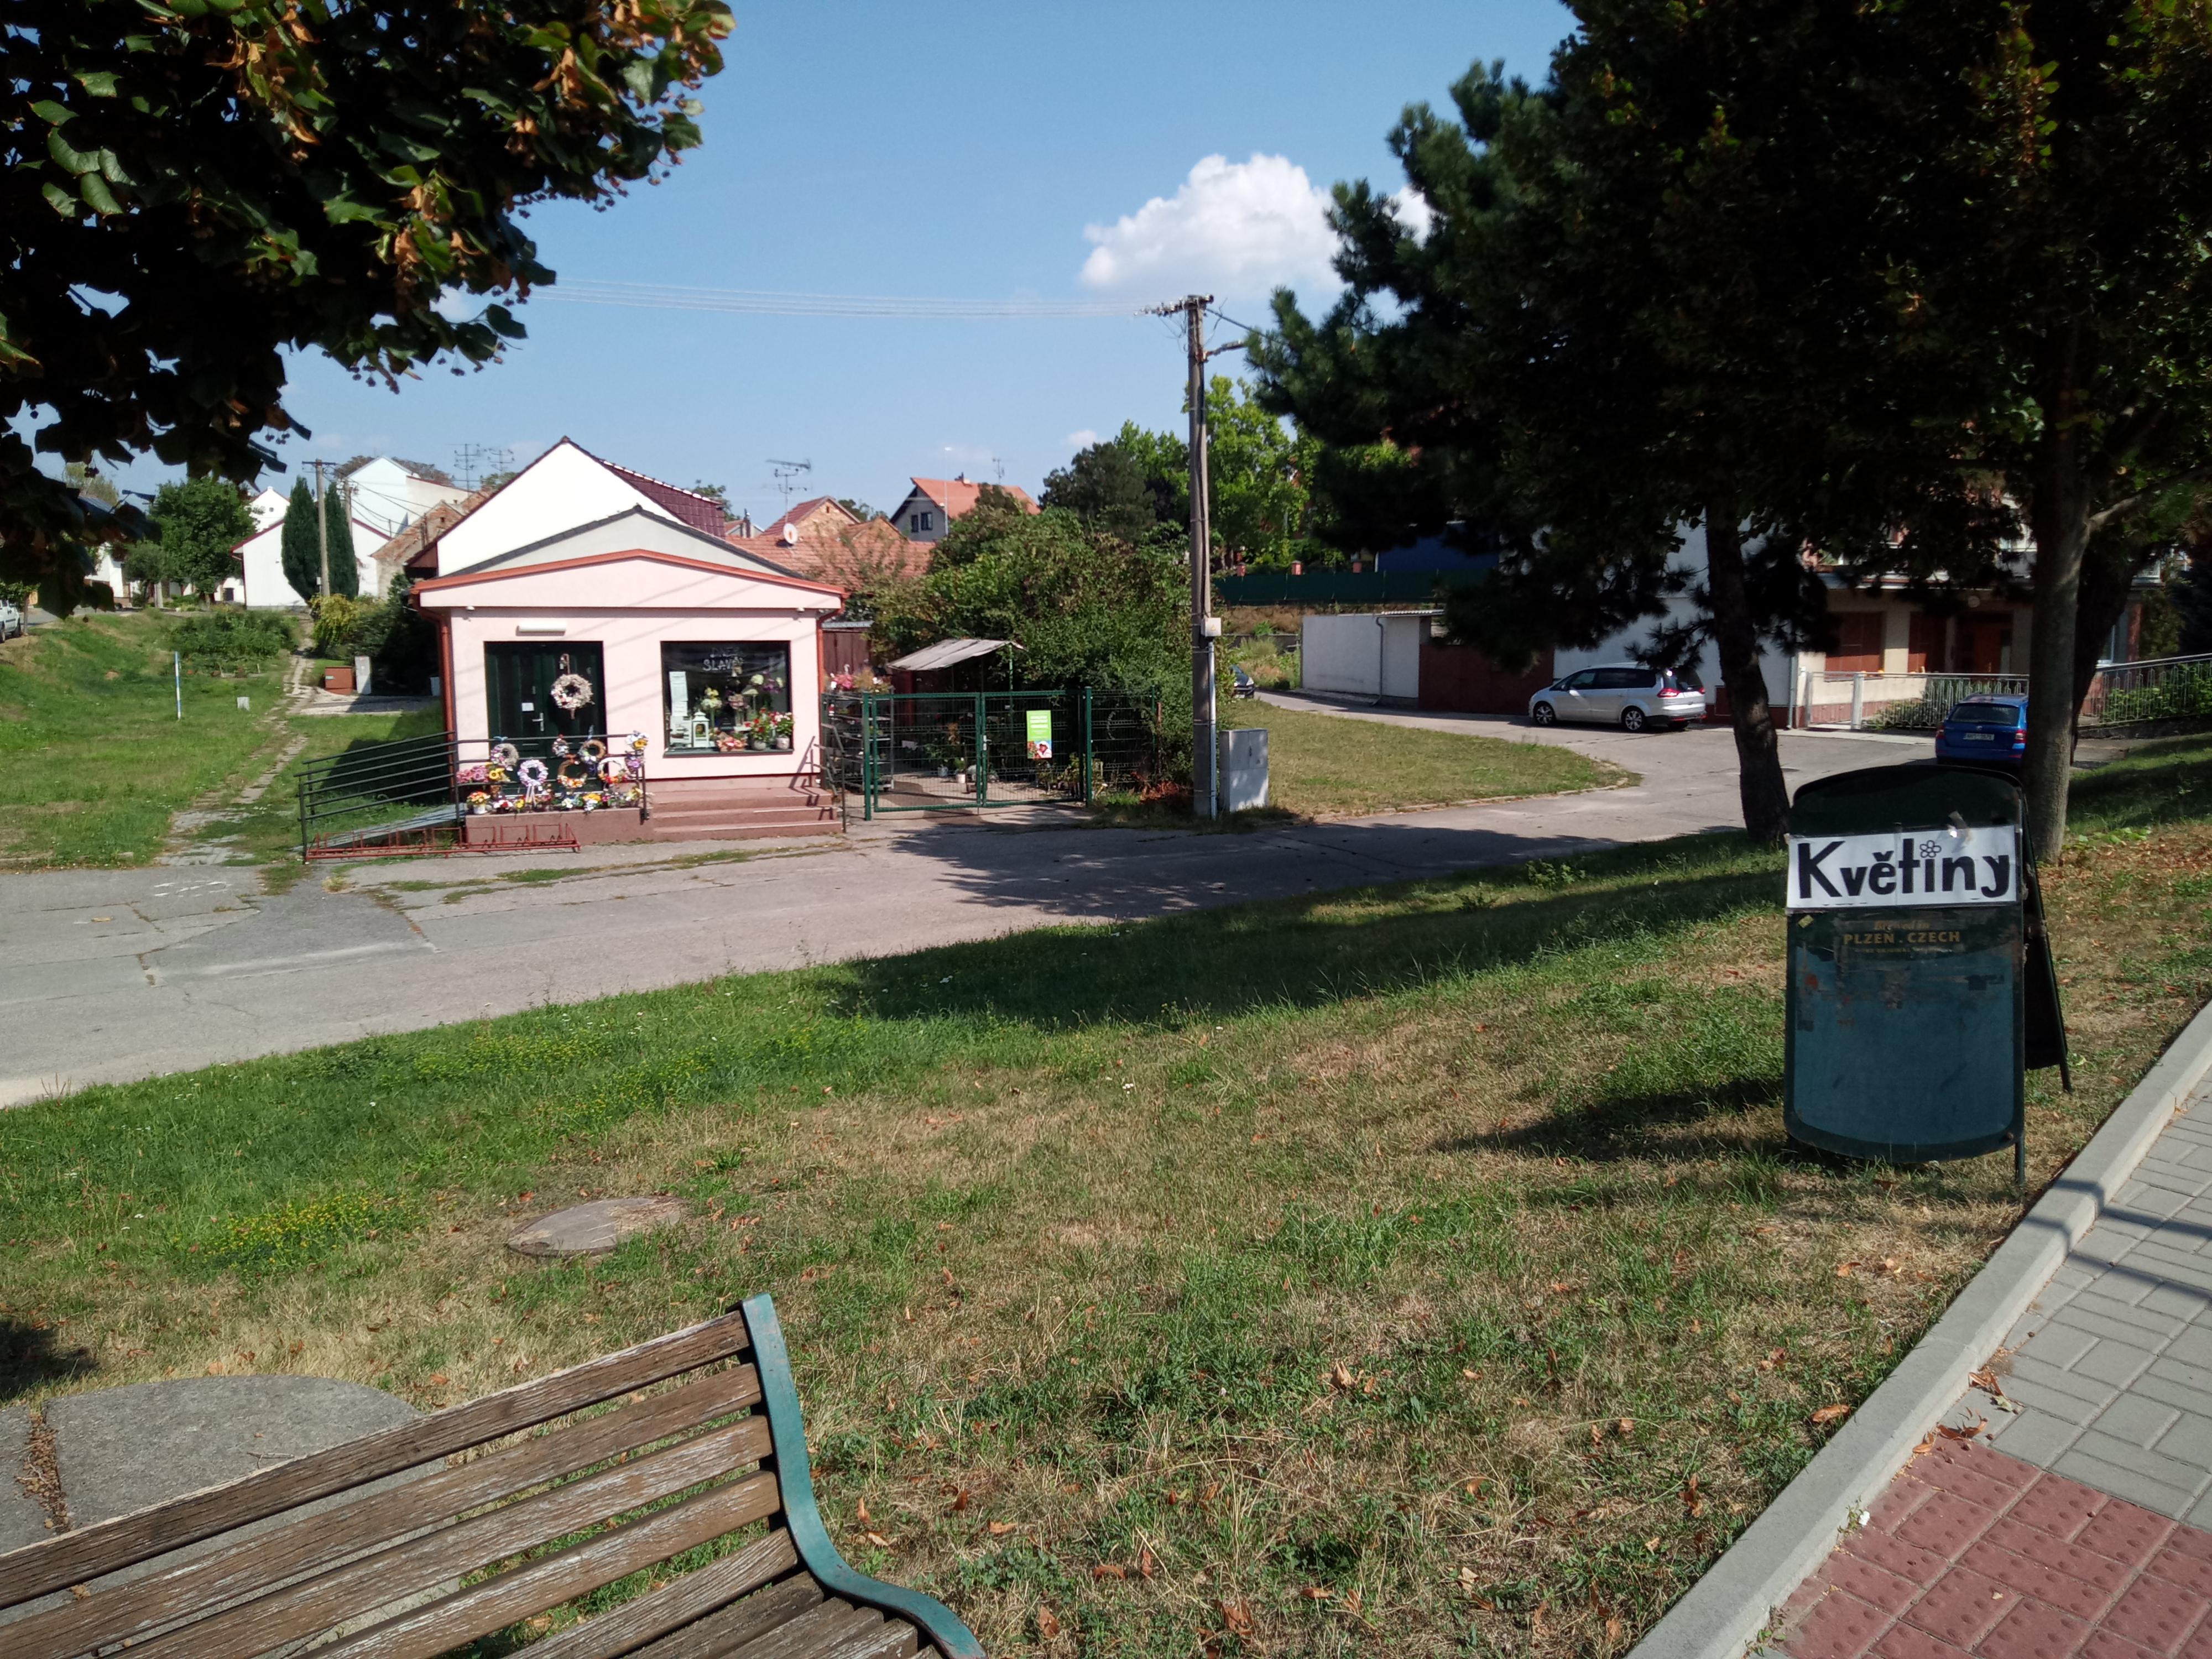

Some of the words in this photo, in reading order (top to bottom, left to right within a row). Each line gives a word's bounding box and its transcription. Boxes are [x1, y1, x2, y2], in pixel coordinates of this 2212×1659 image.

[703, 659, 734, 671] SLAV
[1798, 838, 2010, 899] Květiny
[1907, 931, 1960, 943] CZECH
